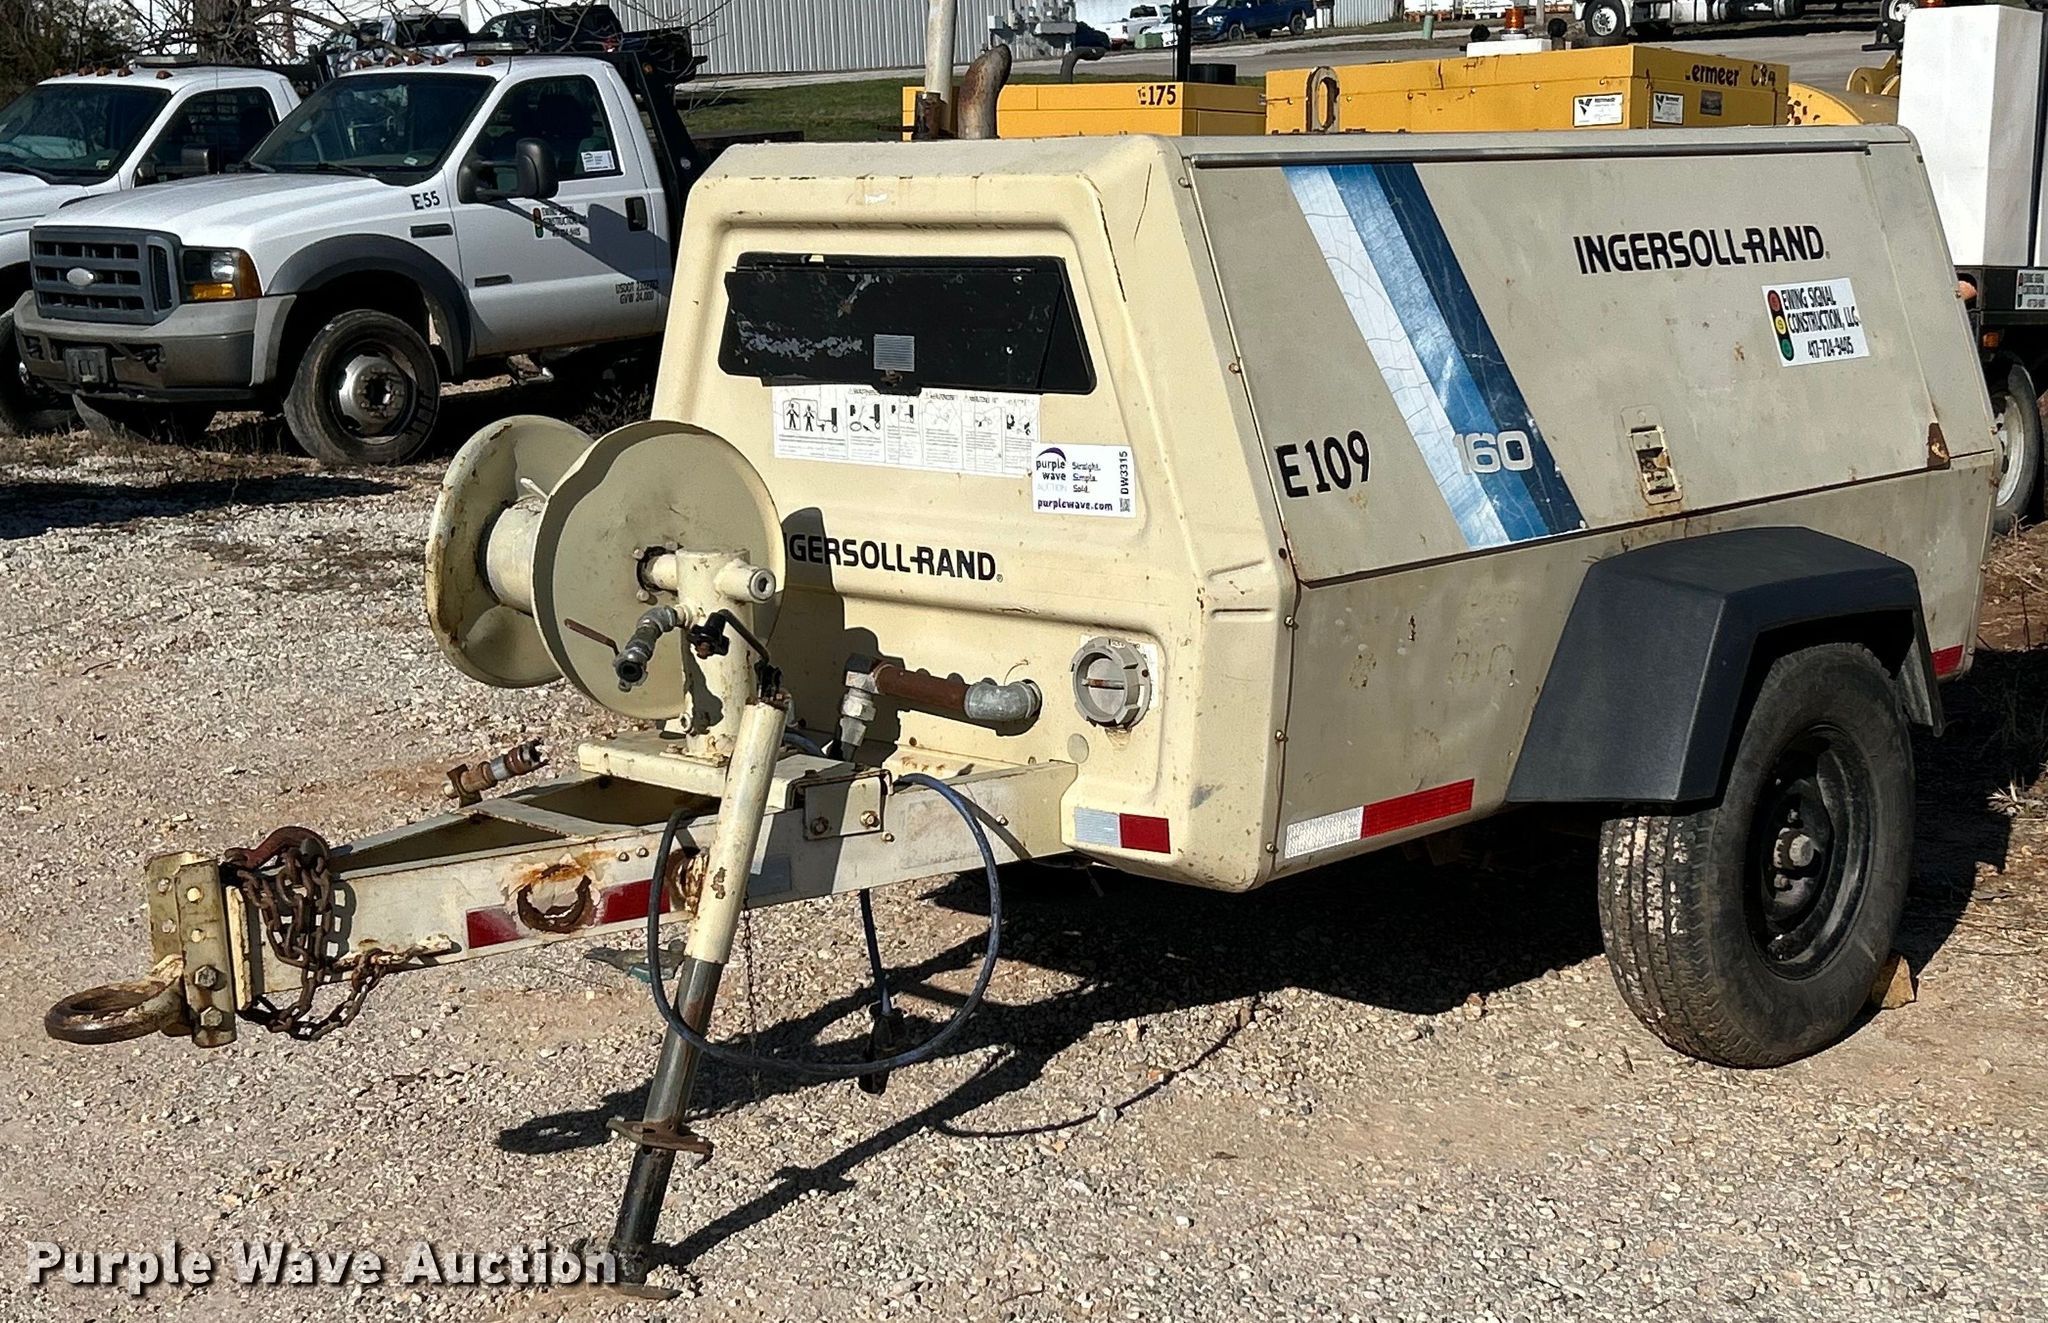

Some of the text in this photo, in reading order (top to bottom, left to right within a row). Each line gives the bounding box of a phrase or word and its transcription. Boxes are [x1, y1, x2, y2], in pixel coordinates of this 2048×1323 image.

[1685, 64, 1740, 86] ermeer
[411, 190, 441, 210] E55
[1573, 224, 1824, 275] INGERSOLL-RAND
[1780, 285, 1837, 310] EWING SIGNAL
[1787, 306, 1860, 334] CONSTRUCTION, LLC
[1035, 459, 1066, 472] purple
[1275, 430, 1370, 498] E109
[1453, 430, 1533, 475] 160
[1042, 472, 1067, 481] wave
[1118, 450, 1129, 495] DW3315
[1037, 498, 1114, 512] purplewave.com
[784, 533, 997, 581] GERSOLL-RAND
